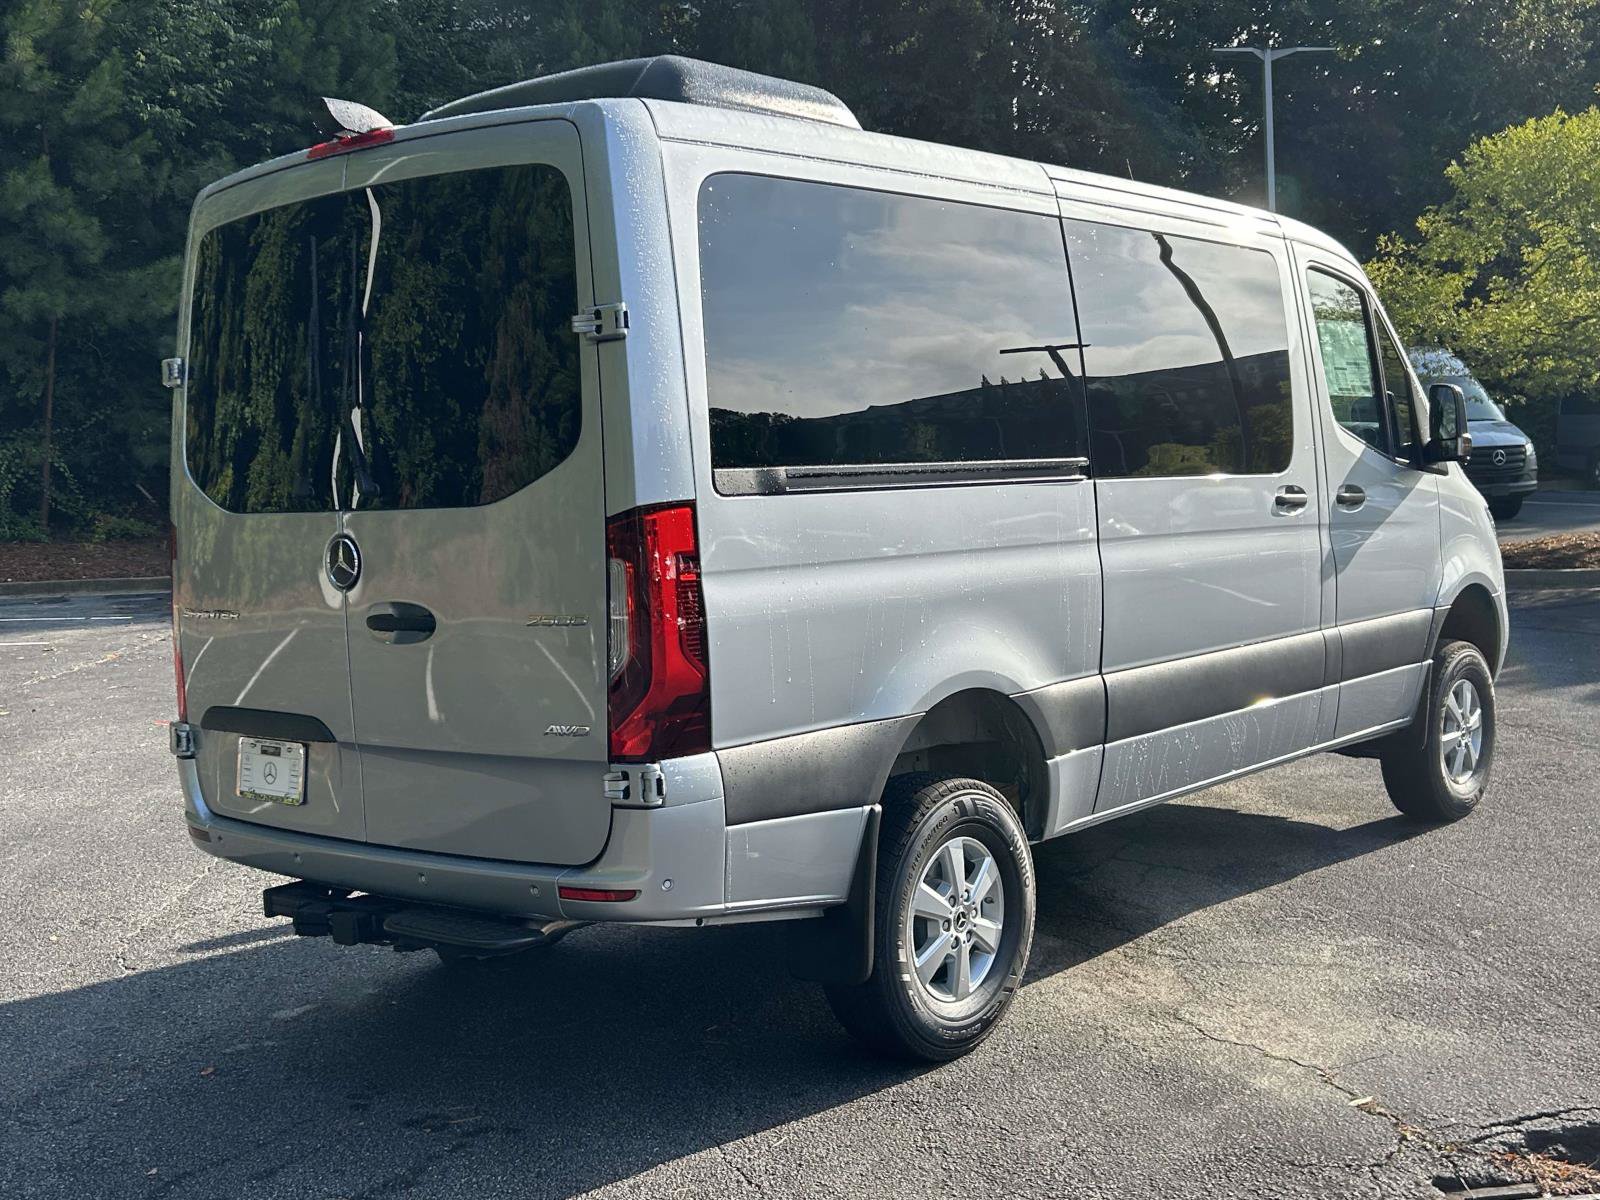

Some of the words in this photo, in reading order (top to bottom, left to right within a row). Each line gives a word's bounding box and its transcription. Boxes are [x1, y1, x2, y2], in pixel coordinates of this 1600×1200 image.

[525, 615, 590, 627] 2500
[543, 724, 591, 737] AWD
[1009, 829, 1031, 889] KUMHO
